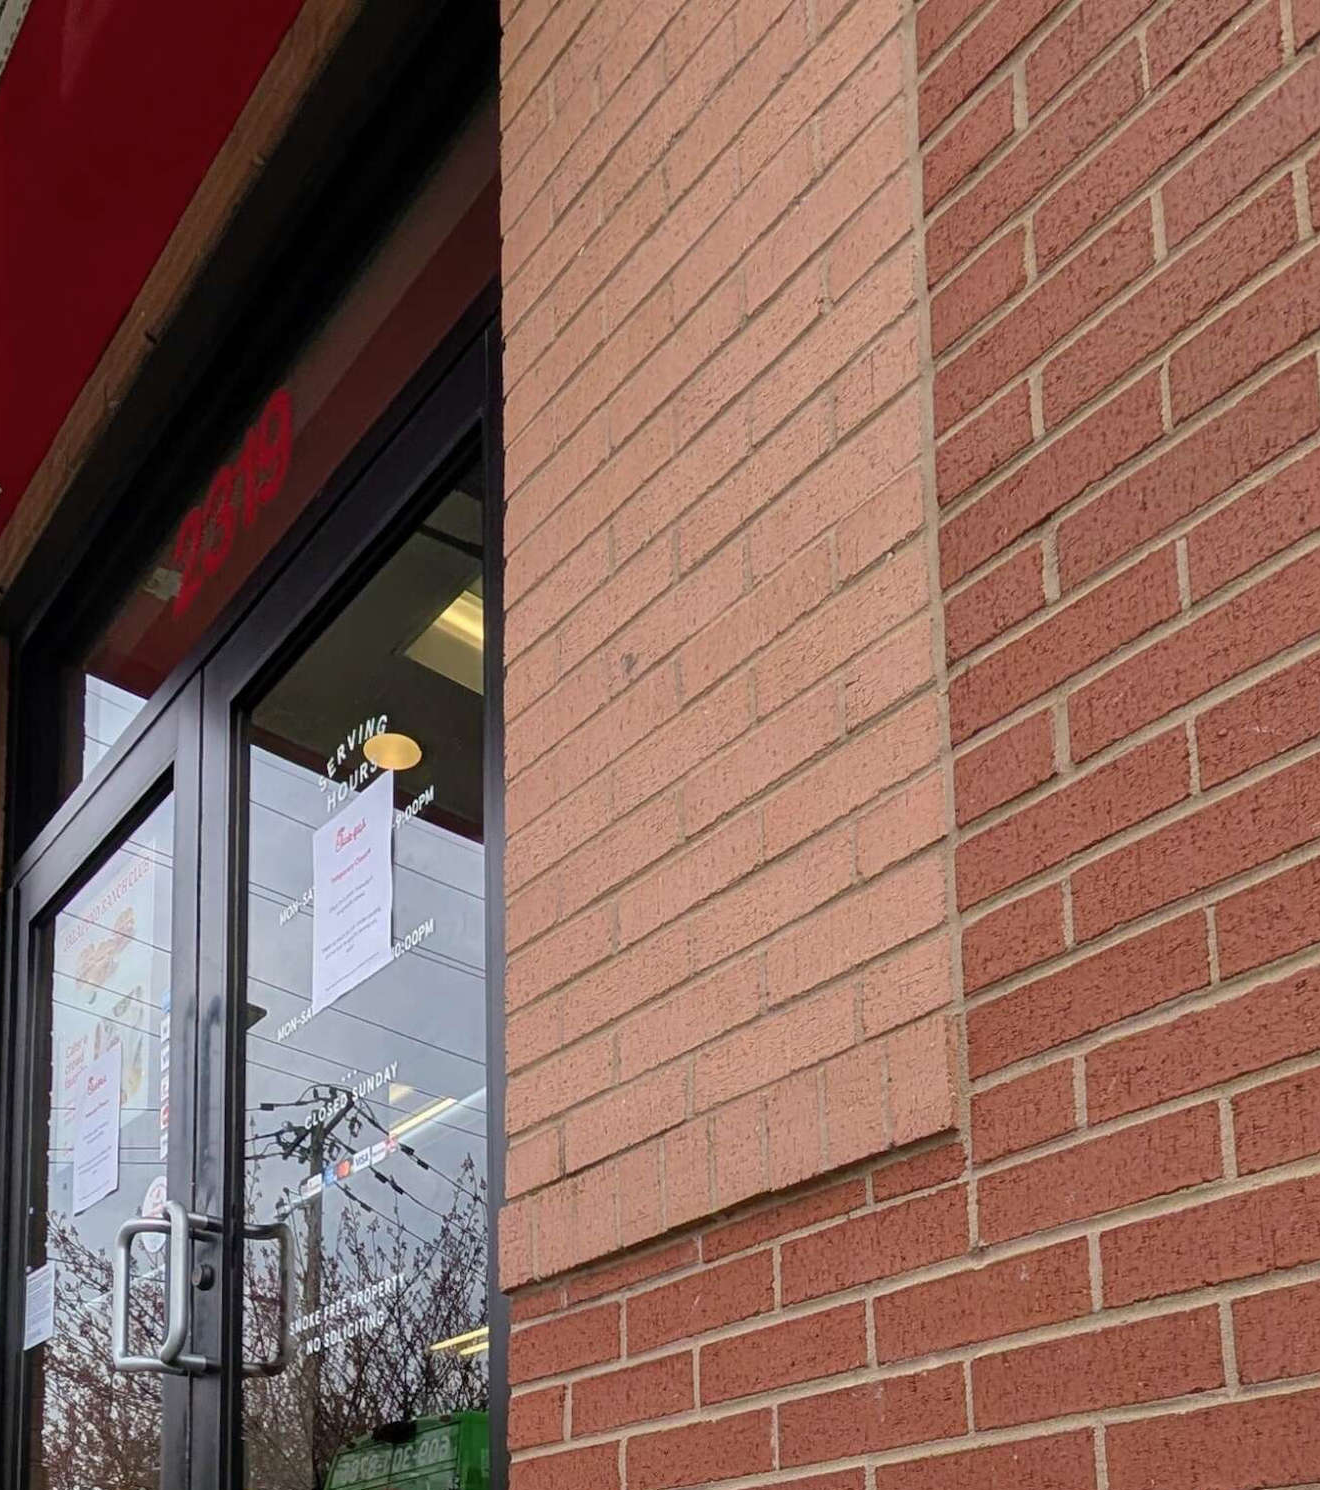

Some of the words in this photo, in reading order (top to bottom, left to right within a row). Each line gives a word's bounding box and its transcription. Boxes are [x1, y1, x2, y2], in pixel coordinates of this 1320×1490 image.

[318, 714, 388, 792] SERVING
[327, 756, 378, 813] HOURS
[279, 887, 313, 927] MON-SA
[277, 1007, 312, 1042] MON-SA
[304, 1094, 348, 1130] CLOSED
[351, 1061, 397, 1101] SUNDAY
[289, 1310, 321, 1336] SMOKE
[324, 1298, 348, 1321] FREE
[350, 1273, 405, 1308] PROPERTY
[306, 1337, 321, 1355] NO
[324, 1310, 385, 1348] SOLICITING
